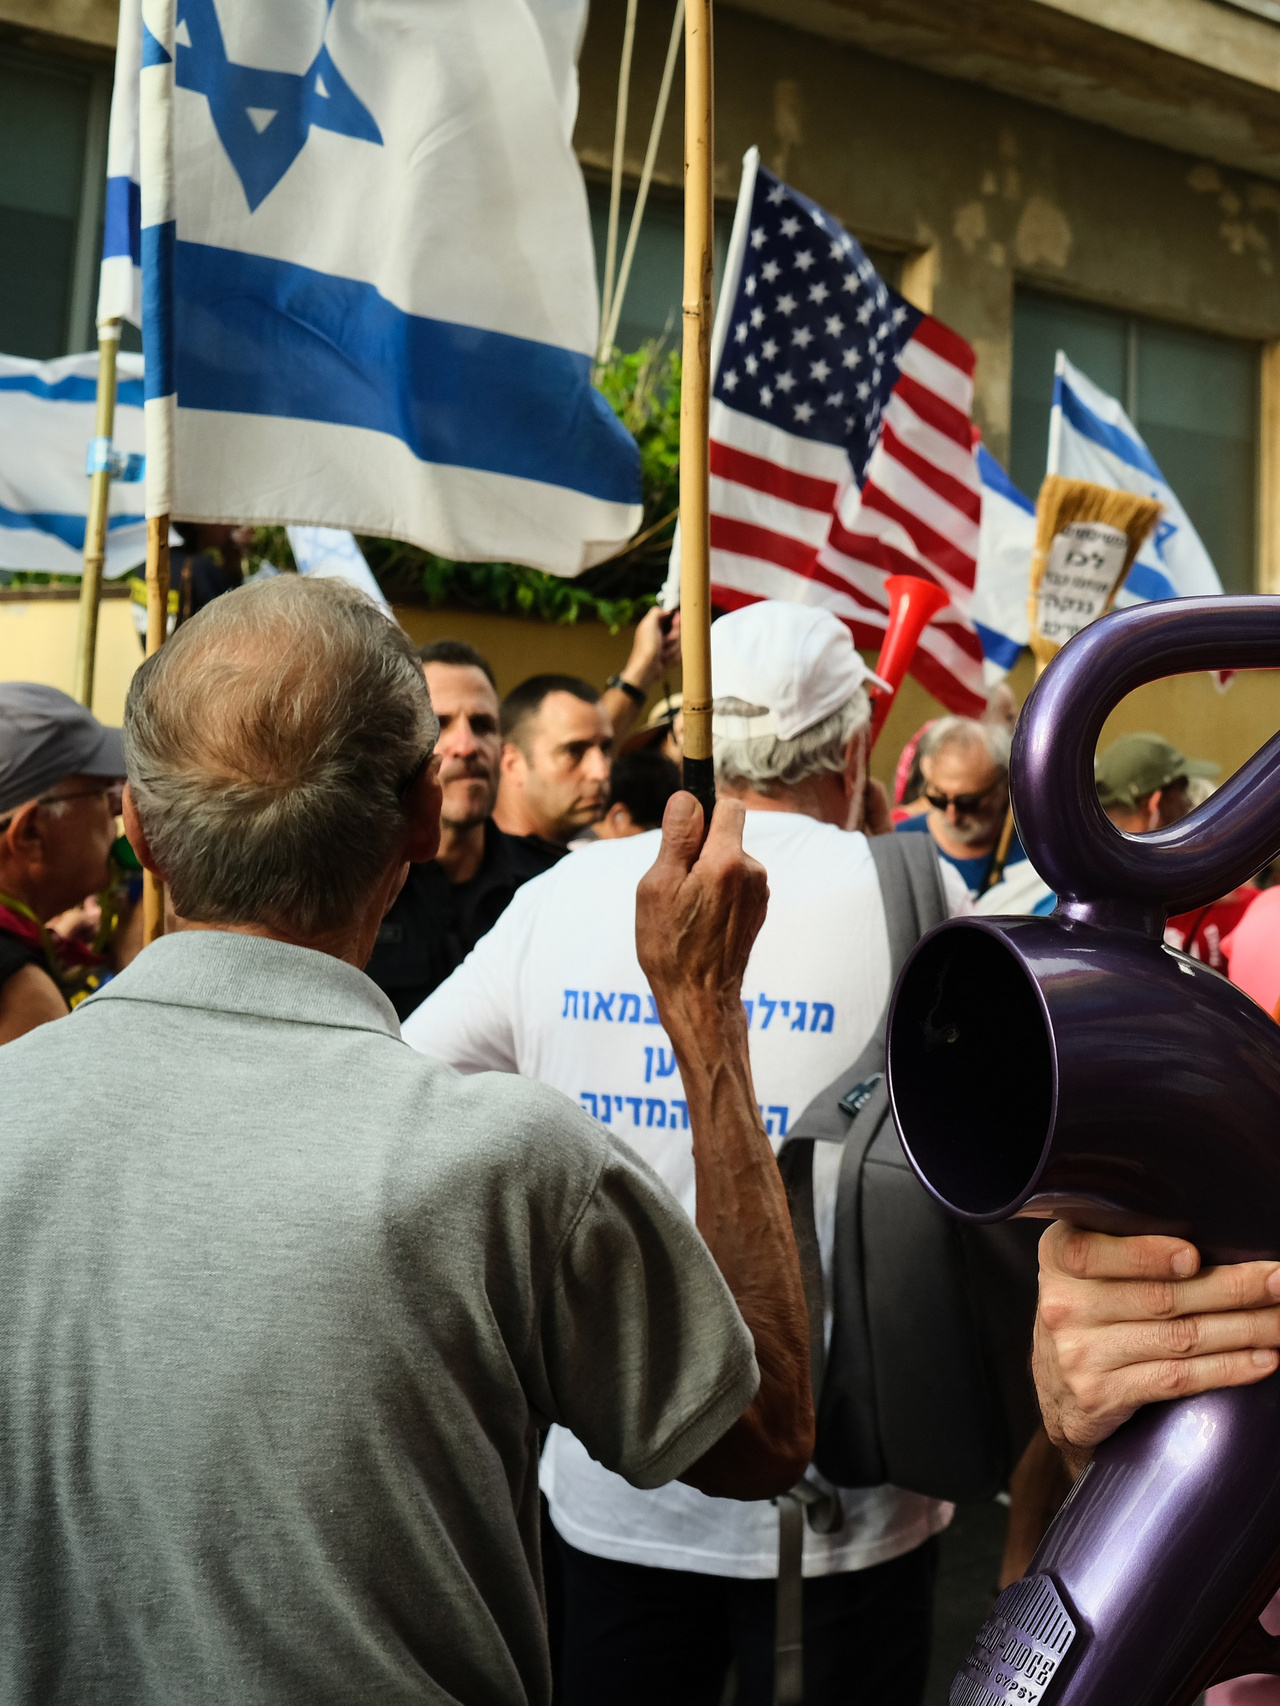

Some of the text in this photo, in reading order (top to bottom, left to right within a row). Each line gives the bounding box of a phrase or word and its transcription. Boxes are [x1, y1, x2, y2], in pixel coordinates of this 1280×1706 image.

[562, 989, 661, 1025] צמאות
[644, 1046, 677, 1084] ען
[580, 1092, 689, 1129] המדינה
[995, 1671, 1038, 1704] GYPSY
